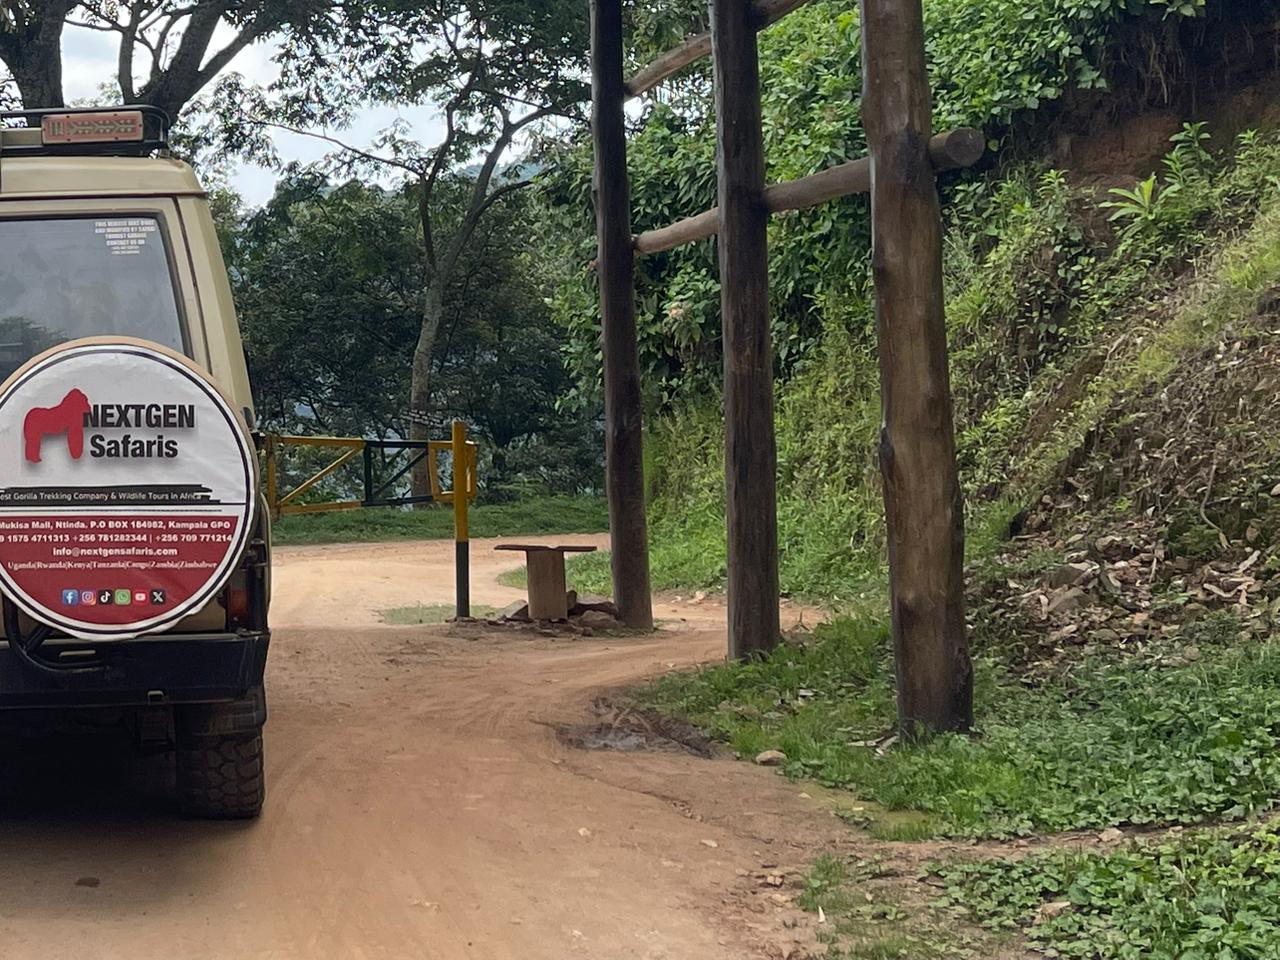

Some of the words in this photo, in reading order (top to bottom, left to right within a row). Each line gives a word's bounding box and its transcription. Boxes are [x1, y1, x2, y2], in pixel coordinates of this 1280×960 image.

[82, 403, 195, 429] NEXTGEN
[90, 434, 178, 458] Safaris
[40, 492, 72, 501] Trekking
[73, 492, 108, 501] Company
[119, 492, 146, 500] Wildlife
[148, 492, 169, 500] Tours
[90, 520, 106, 529] P.O
[108, 520, 128, 529] BOX
[168, 520, 208, 530] Kampala
[210, 521, 231, 529] GPO
[31, 534, 70, 543] 4711313
[72, 534, 96, 542] +256
[155, 534, 178, 542] +256
[180, 534, 198, 542] 709
[199, 534, 233, 542] 771214
[53, 547, 178, 557] info@nextgensafaris.com
